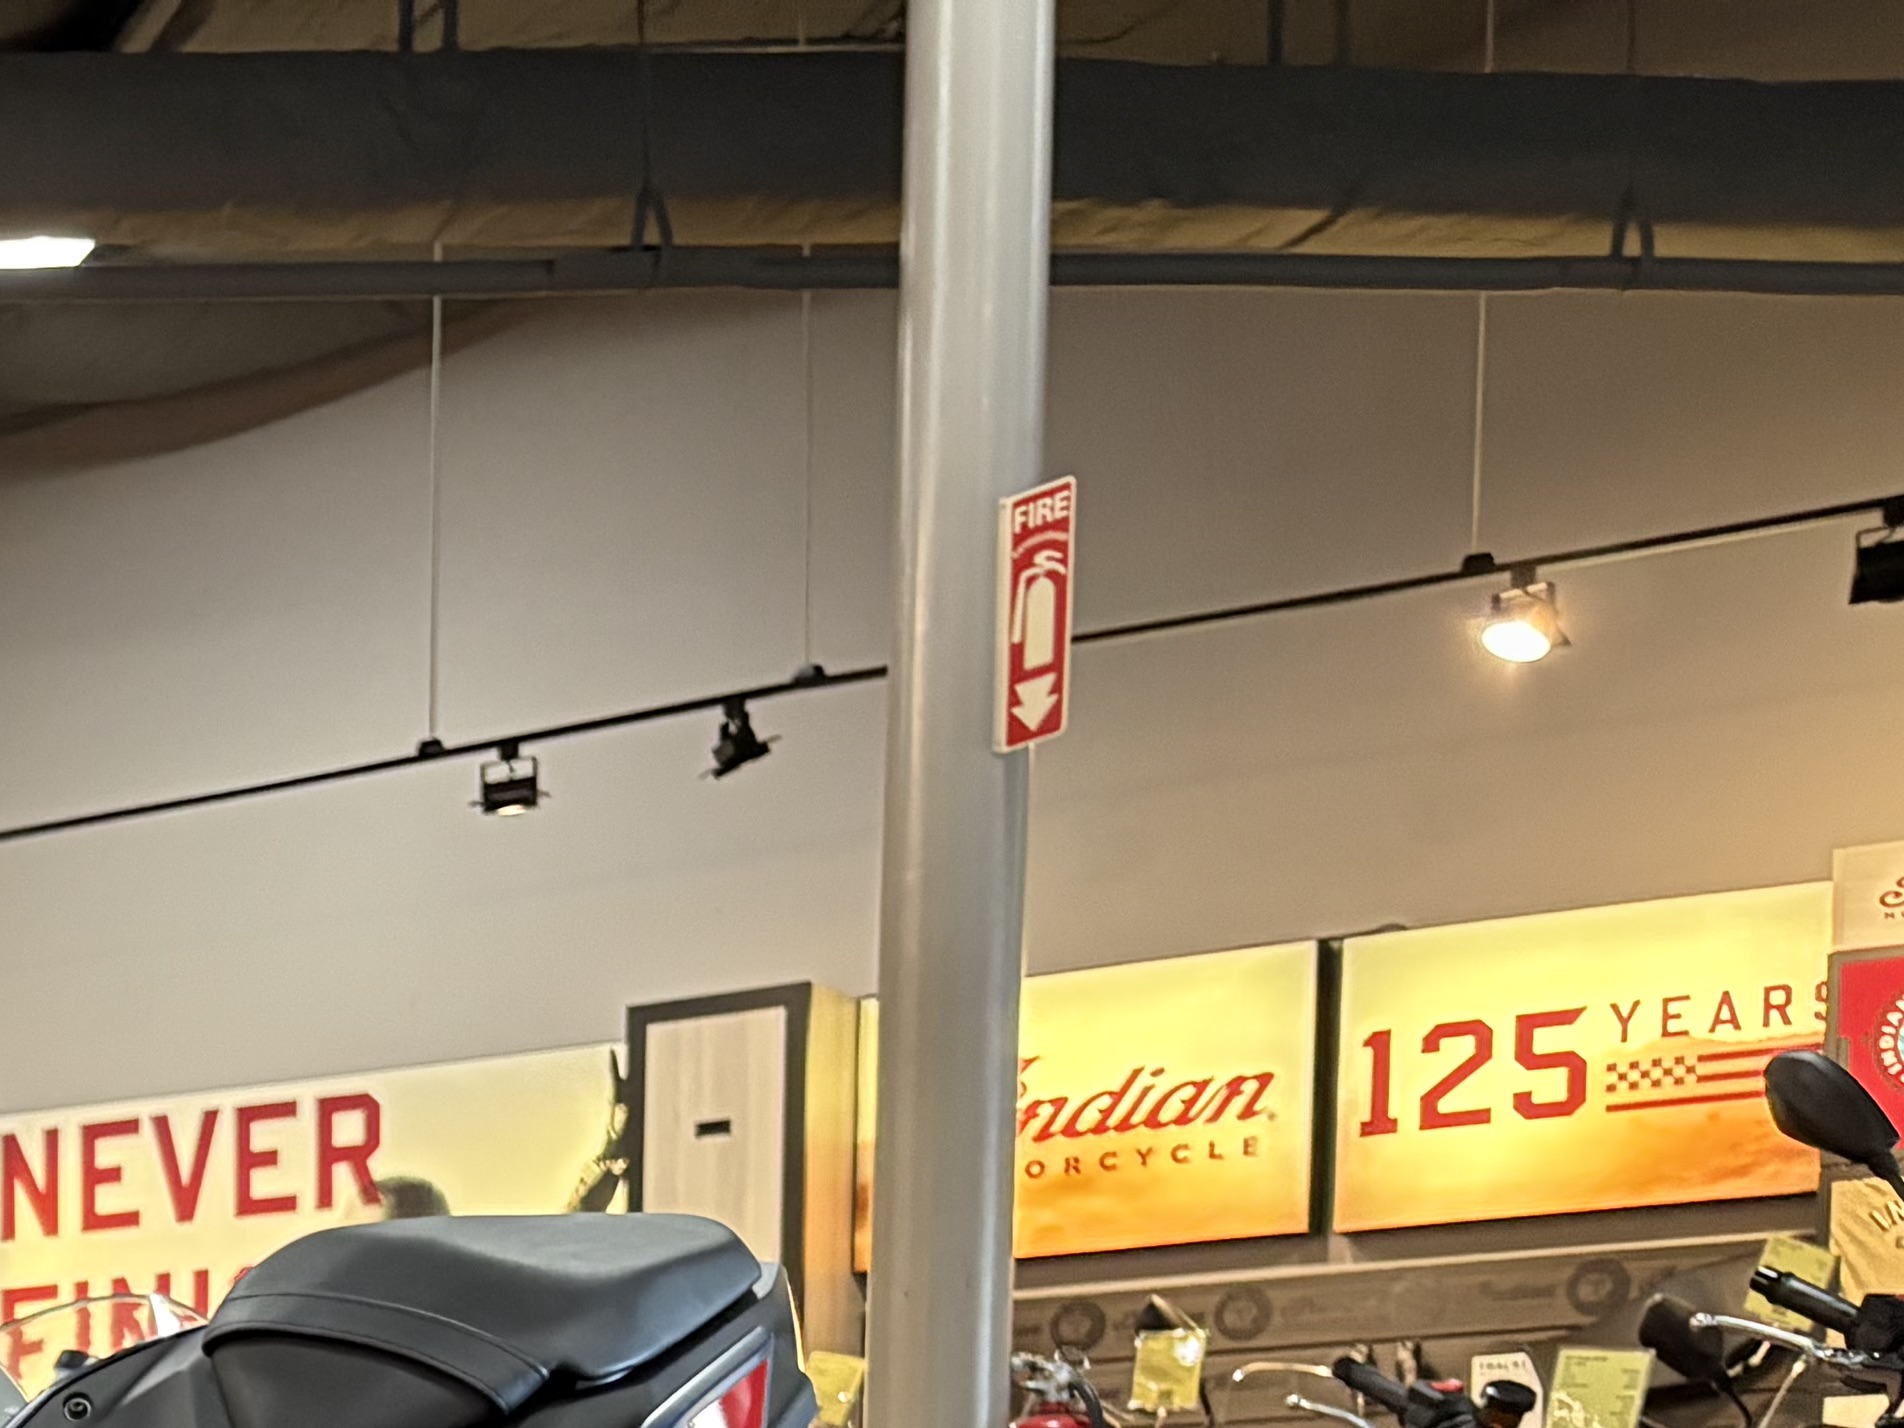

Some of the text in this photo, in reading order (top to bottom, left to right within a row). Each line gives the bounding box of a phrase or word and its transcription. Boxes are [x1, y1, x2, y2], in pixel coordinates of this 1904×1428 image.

[1014, 491, 1071, 534] FIRE
[1359, 1005, 1588, 1138] 125
[0, 1092, 386, 1243] NEVER
[1024, 1136, 1260, 1179] ORCYCLE
